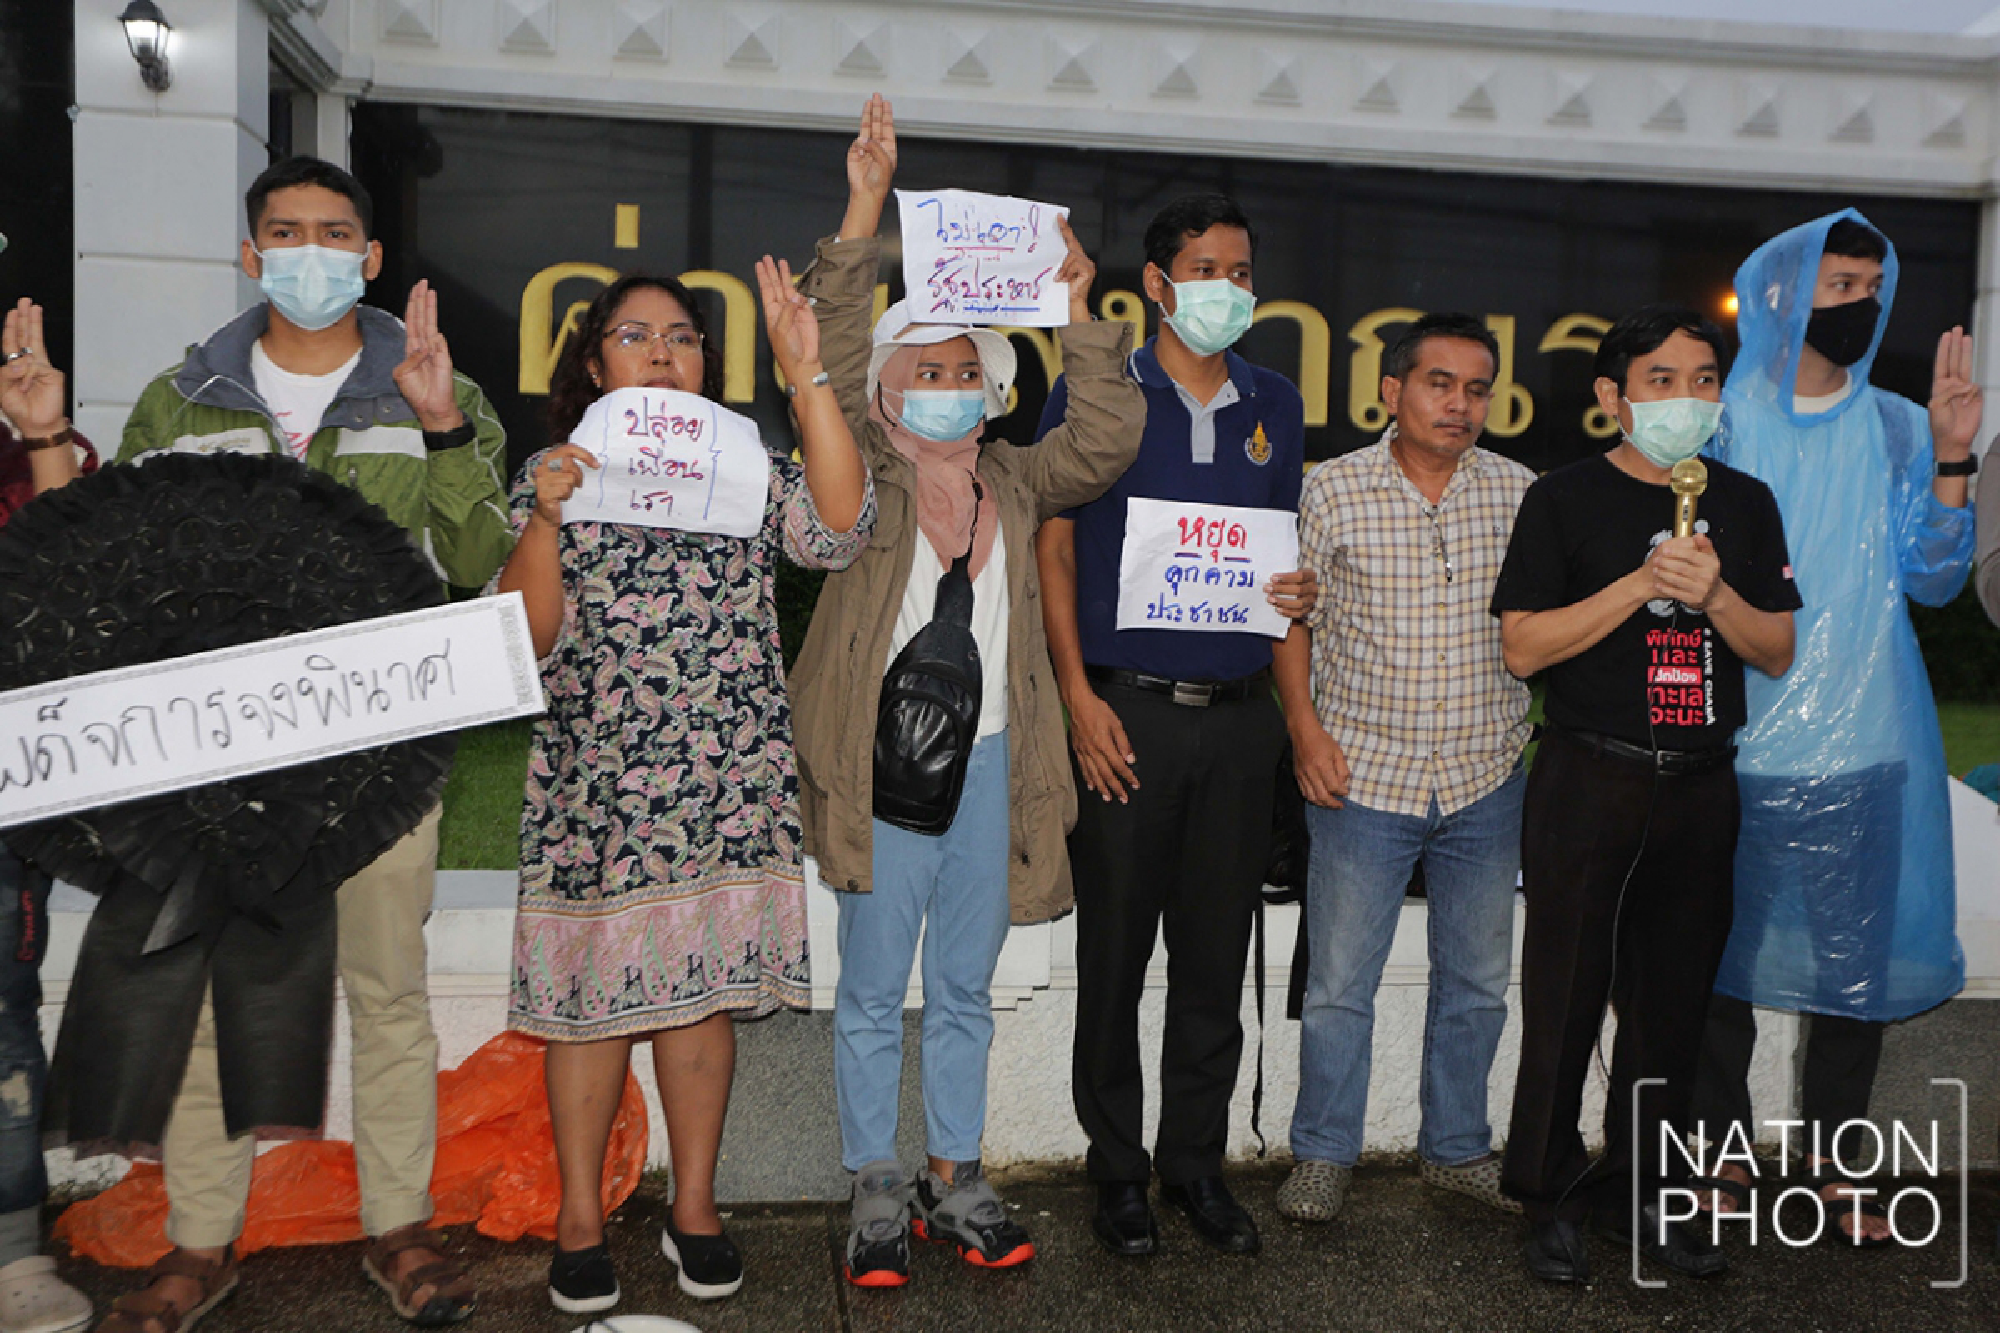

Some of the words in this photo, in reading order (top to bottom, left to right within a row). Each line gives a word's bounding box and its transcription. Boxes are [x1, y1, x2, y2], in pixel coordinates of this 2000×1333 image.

[1177, 515, 1249, 564] หยุด
[1164, 564, 1256, 597] คุกคาม
[1146, 591, 1250, 624] ประชาชน
